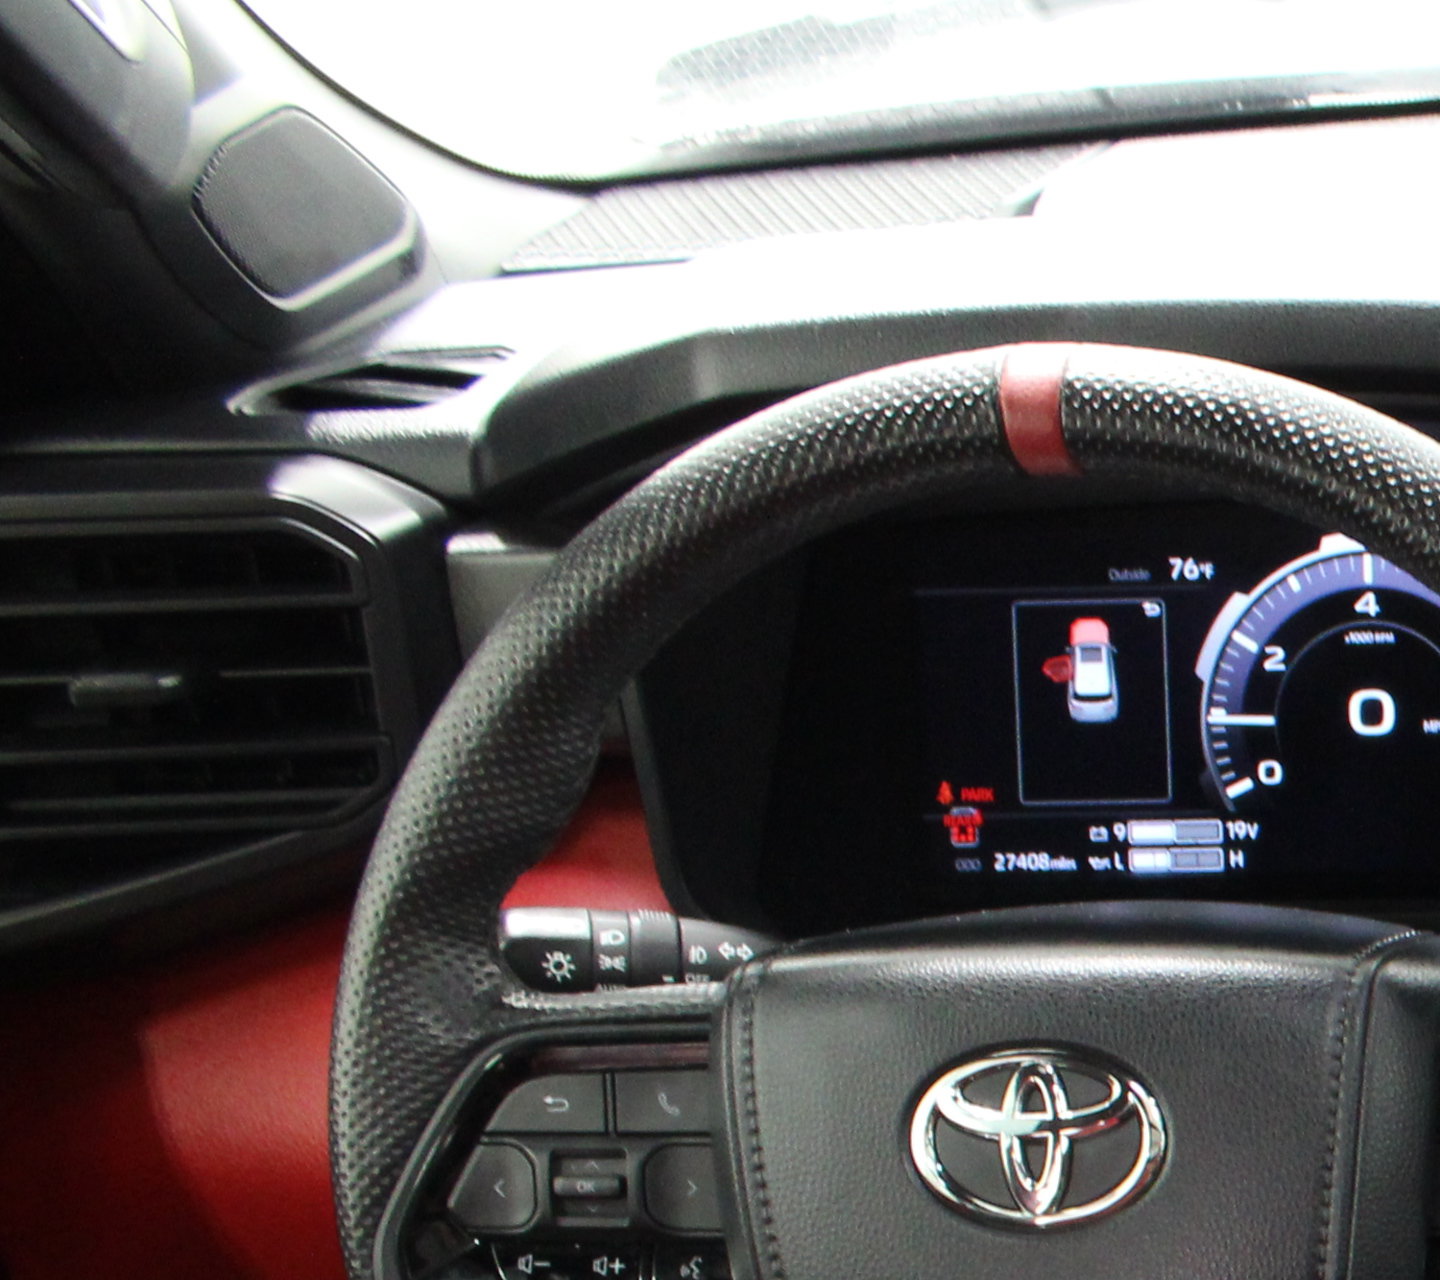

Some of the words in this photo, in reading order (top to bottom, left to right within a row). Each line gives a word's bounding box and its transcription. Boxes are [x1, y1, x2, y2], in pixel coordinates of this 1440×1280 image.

[1354, 591, 1381, 616] 4
[1263, 646, 1287, 671] 2
[1348, 688, 1397, 736] 0
[1257, 760, 1283, 785] 0
[1112, 823, 1126, 842] 9
[1225, 822, 1258, 841] 19V
[1228, 850, 1244, 869] H
